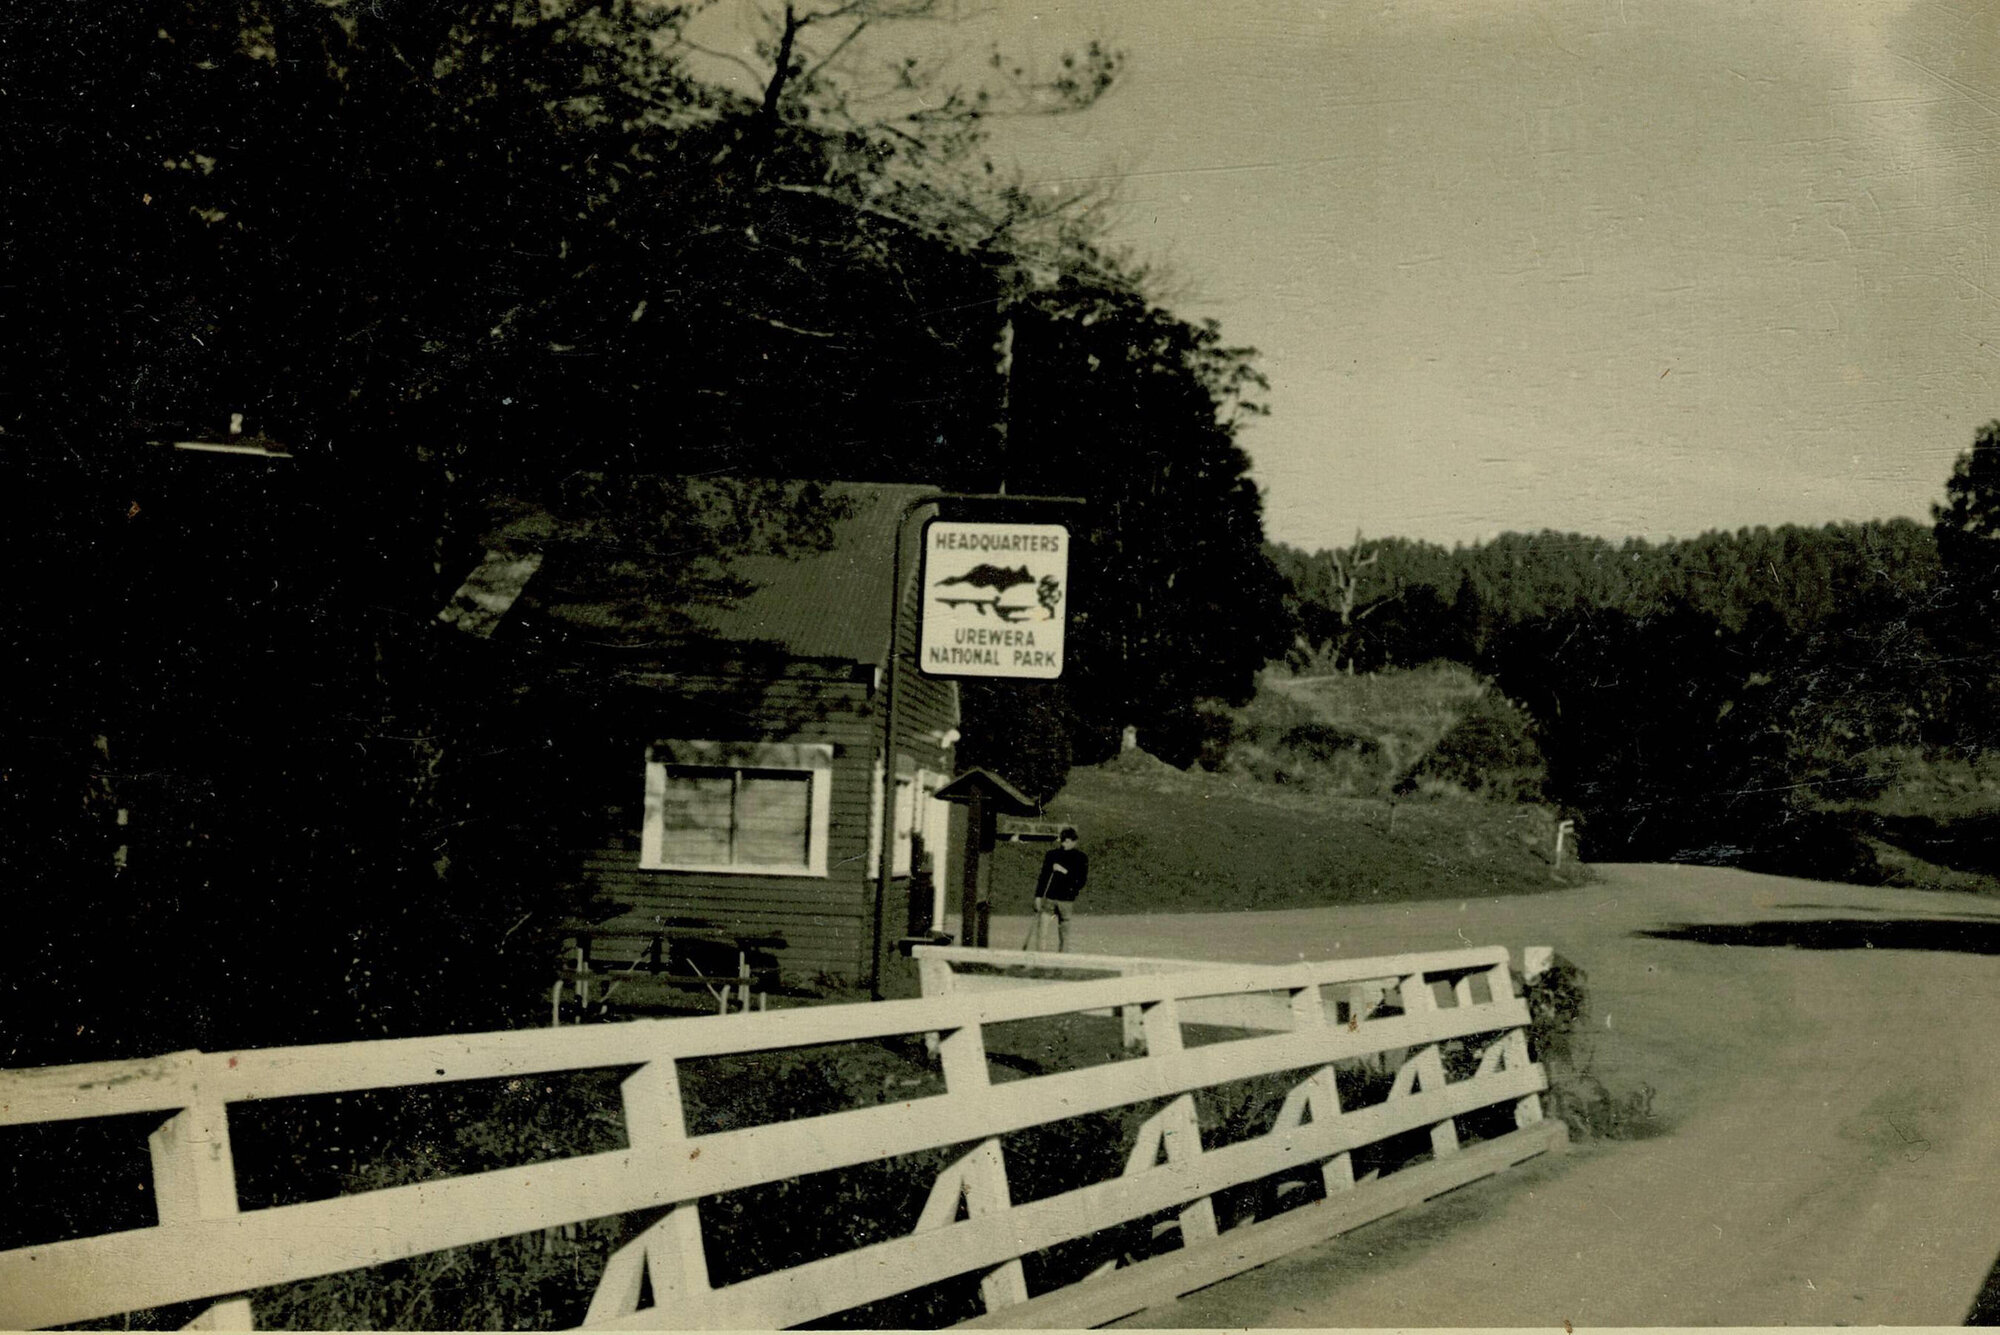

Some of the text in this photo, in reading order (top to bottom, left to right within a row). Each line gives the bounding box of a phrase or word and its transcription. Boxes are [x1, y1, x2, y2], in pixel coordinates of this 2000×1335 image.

[936, 533, 1060, 552] HEADQUARTERS
[955, 628, 1035, 646] UREWERA
[930, 647, 1056, 668] NATIONAL PARK
